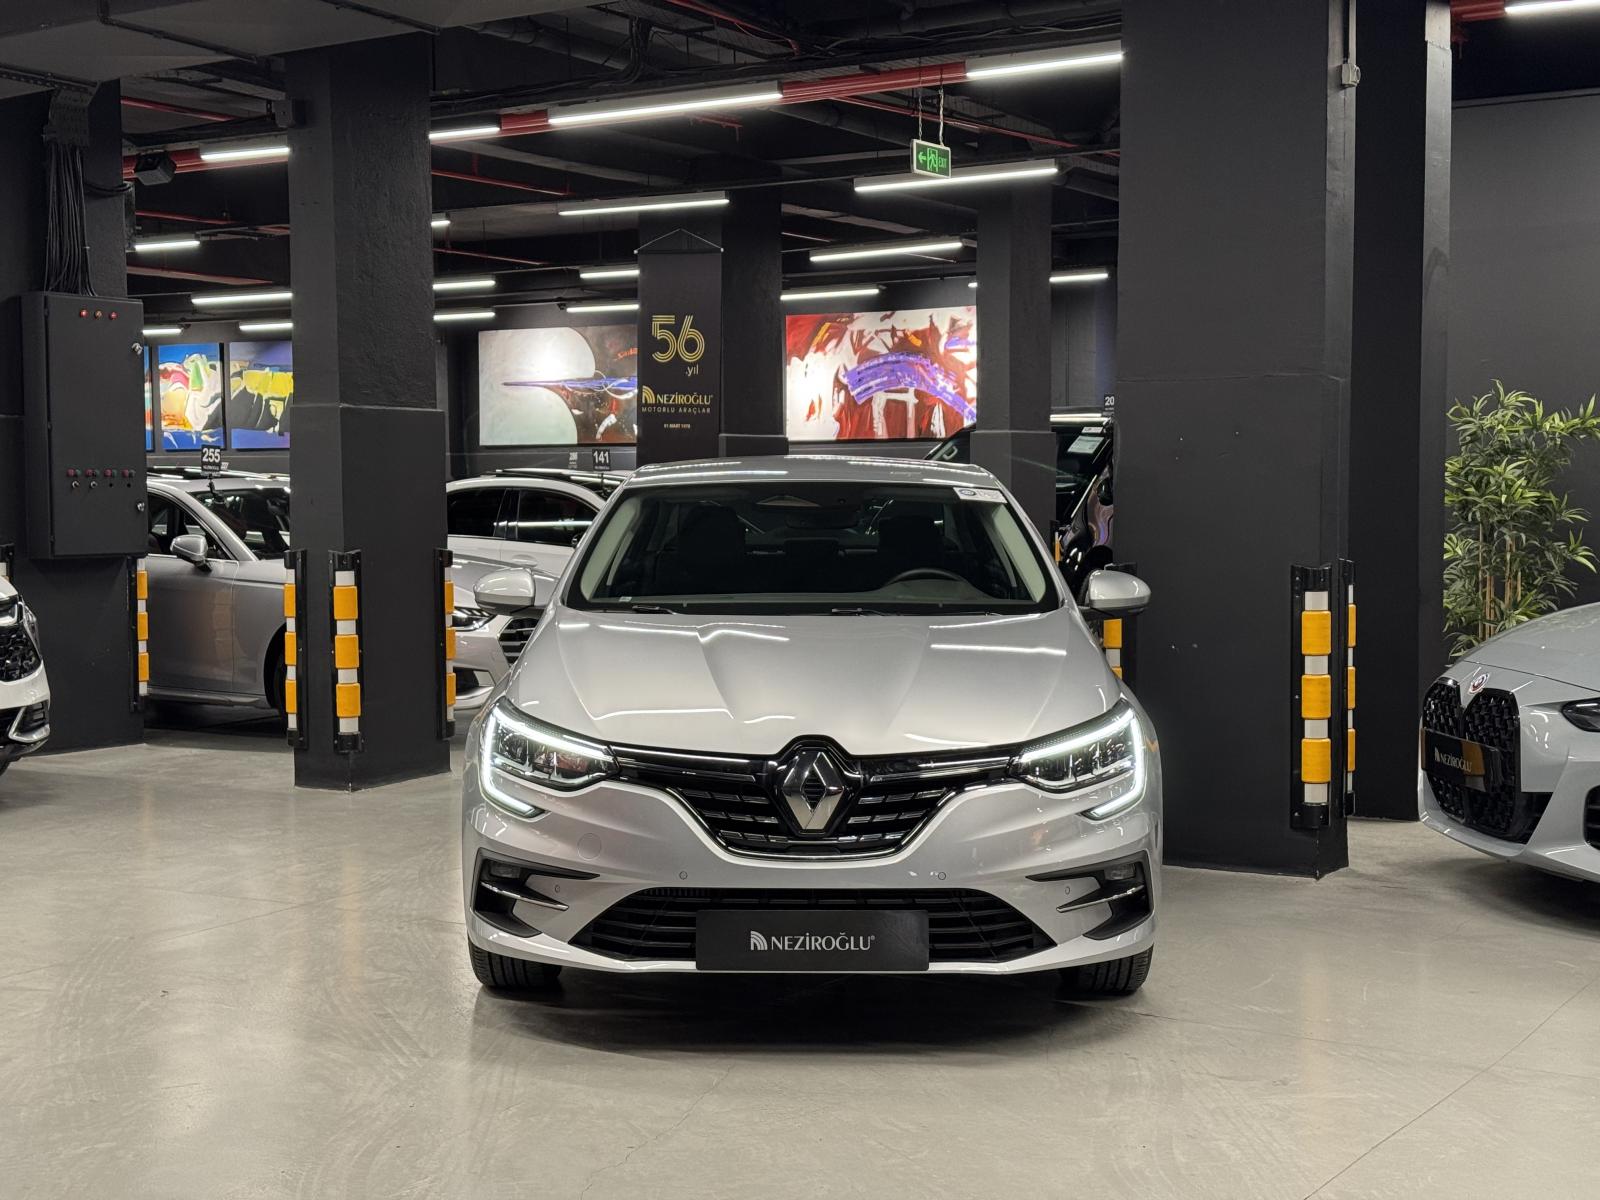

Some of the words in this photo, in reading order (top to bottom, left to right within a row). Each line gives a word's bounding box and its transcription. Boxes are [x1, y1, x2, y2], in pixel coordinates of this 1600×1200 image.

[651, 315, 705, 363] 56
[678, 407, 711, 415] ARAÇLAR
[202, 447, 221, 463] 255
[593, 450, 609, 464] 141
